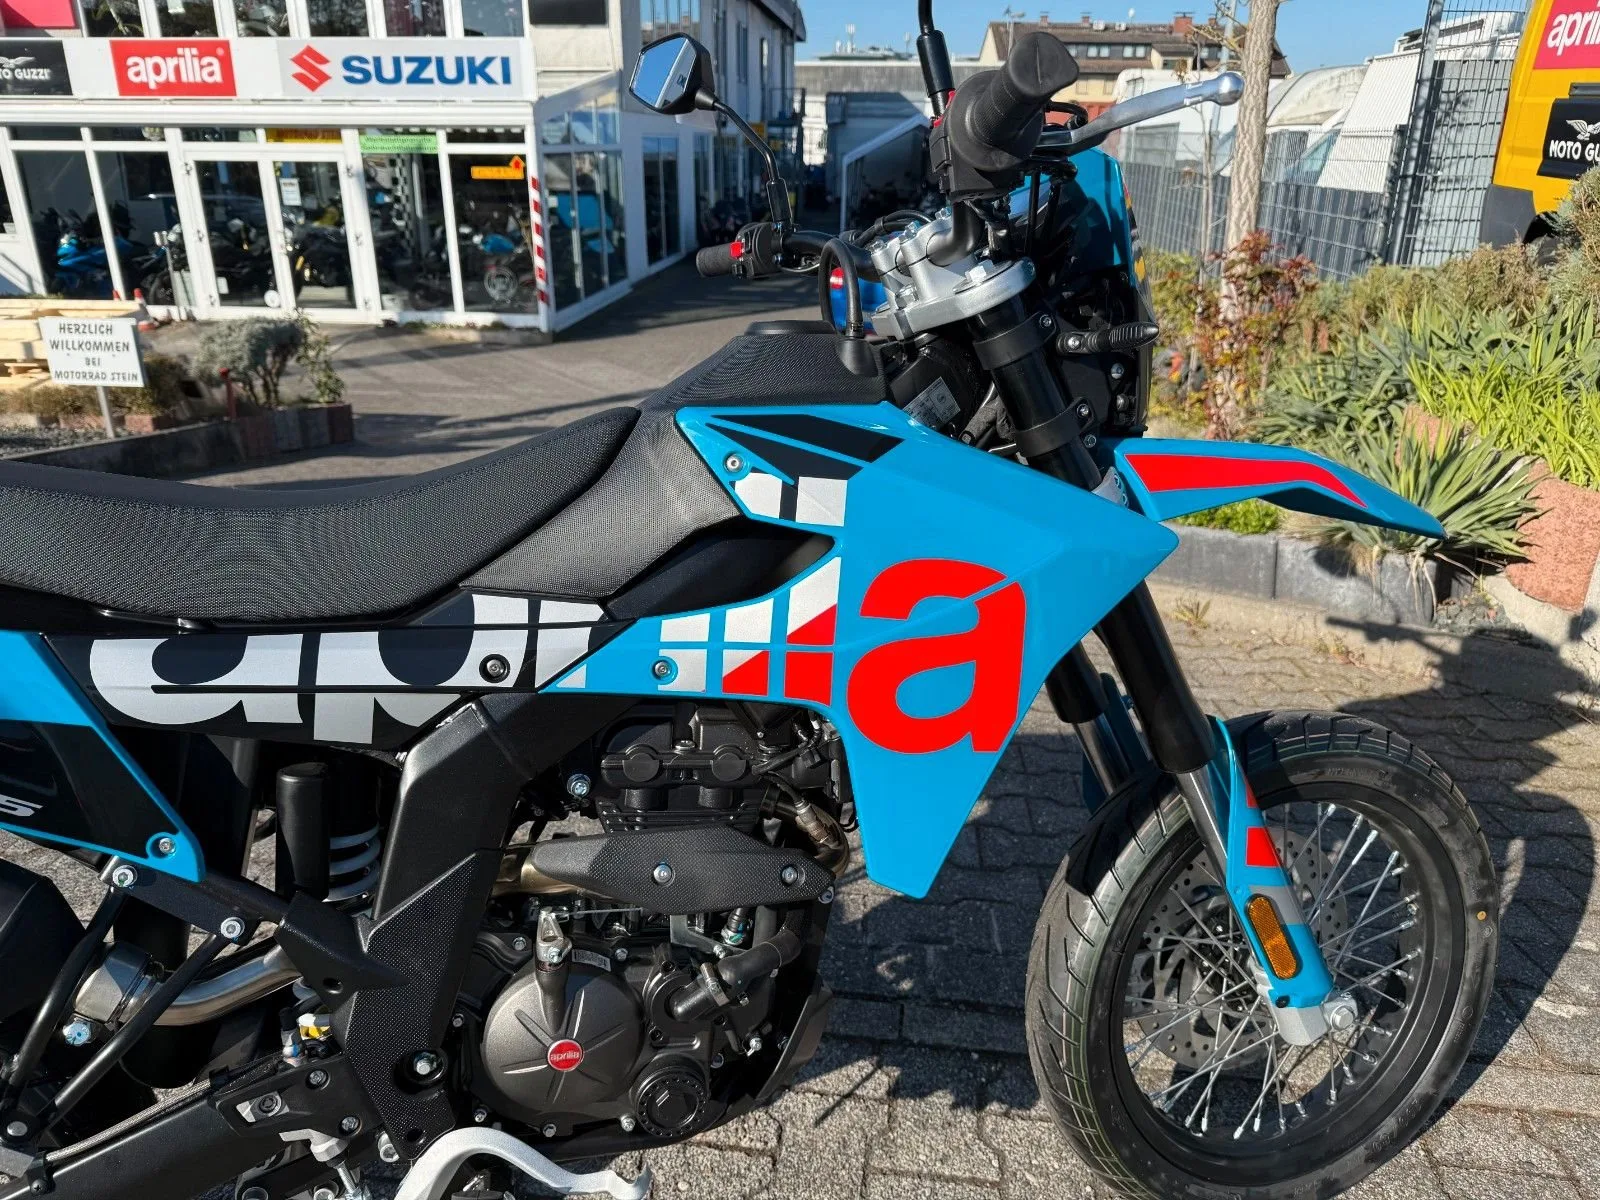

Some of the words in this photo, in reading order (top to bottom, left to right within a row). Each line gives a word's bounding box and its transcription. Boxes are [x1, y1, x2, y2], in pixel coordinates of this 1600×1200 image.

[14, 68, 50, 80] GUZZI
[126, 47, 223, 89] aprilia
[341, 54, 512, 86] SUZUKI
[1549, 140, 1582, 160] MOTO
[58, 322, 113, 335] HERZLICH
[49, 339, 130, 352] WILLKOMMEN
[85, 357, 101, 367] BEI
[54, 370, 107, 381] MOTORRAD
[111, 372, 138, 381] STEIN
[550, 1050, 580, 1062] aprilia
